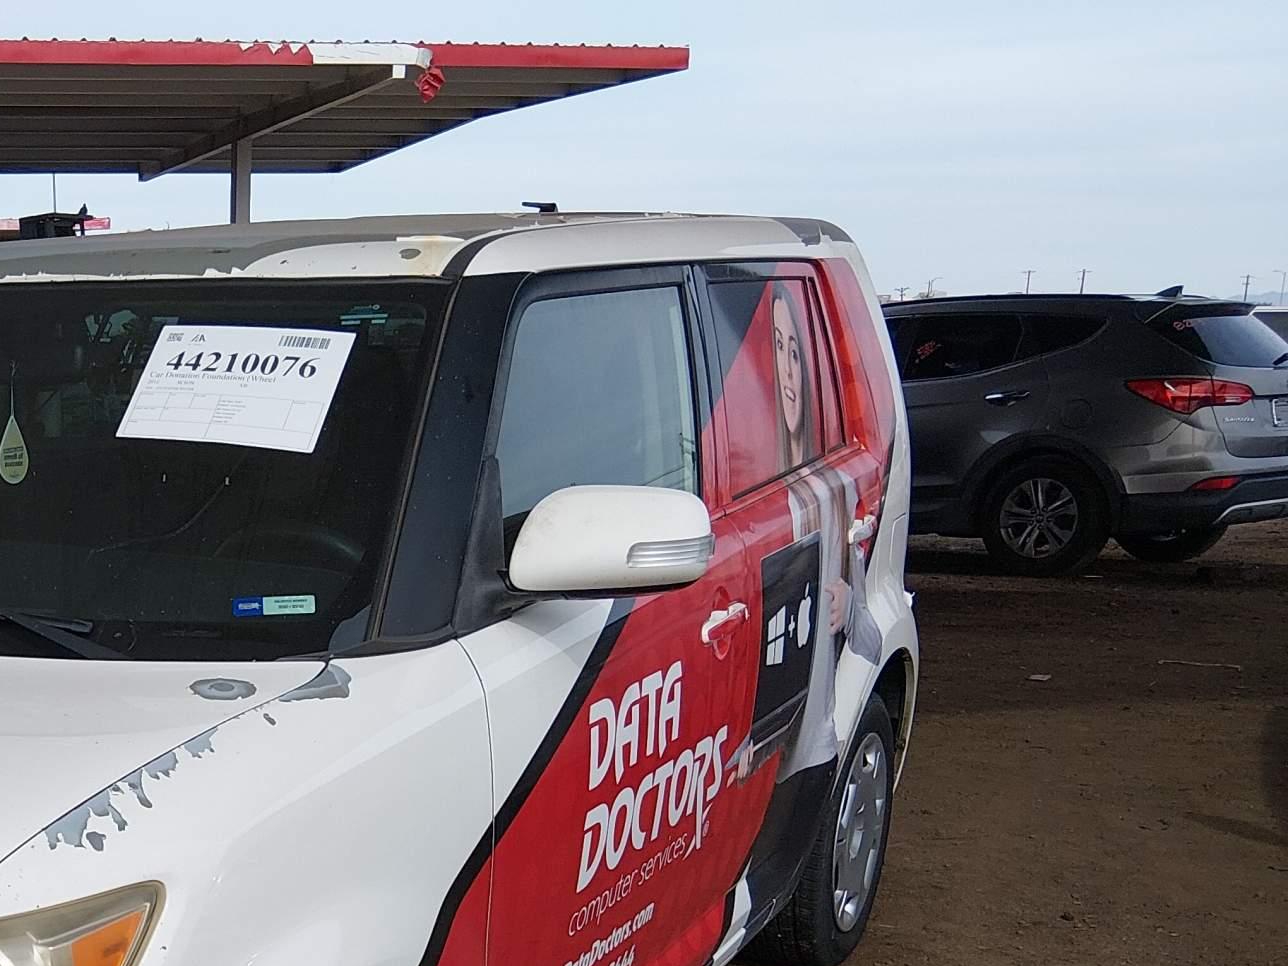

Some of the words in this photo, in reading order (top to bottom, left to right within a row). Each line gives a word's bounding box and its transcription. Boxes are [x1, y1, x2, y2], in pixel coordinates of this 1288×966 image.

[166, 350, 321, 379] 44210076
[201, 373, 245, 382] Foundation
[589, 660, 683, 791] DATA
[576, 724, 728, 894] DOCTORS
[568, 869, 638, 936] computer
[638, 833, 688, 886] services
